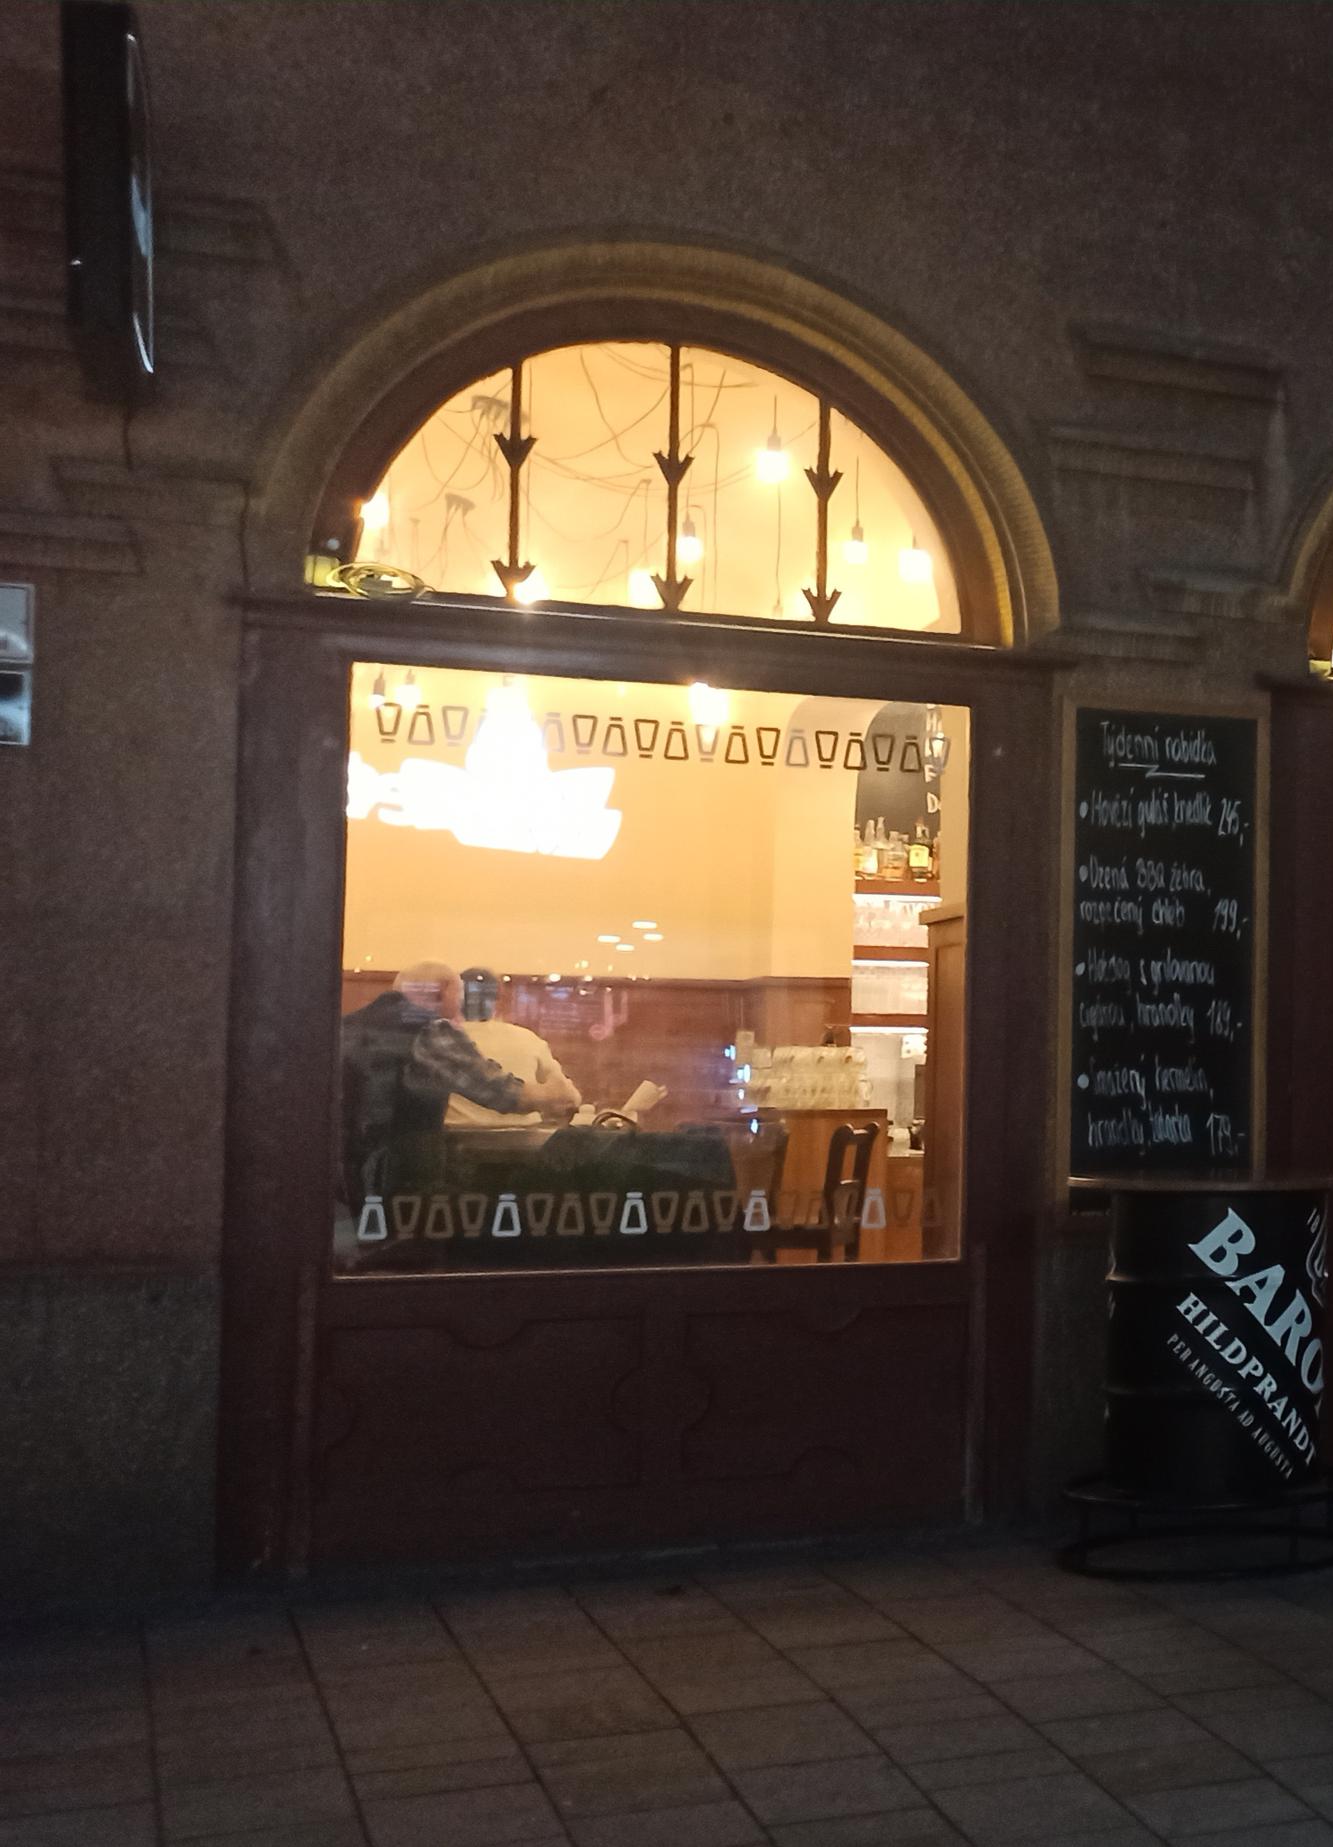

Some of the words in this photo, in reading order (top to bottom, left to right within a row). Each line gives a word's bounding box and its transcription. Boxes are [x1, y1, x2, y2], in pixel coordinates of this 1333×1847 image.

[1187, 1206, 1326, 1400] BARO
[1166, 1333, 1192, 1363] PER
[1237, 1410, 1256, 1428] AD
